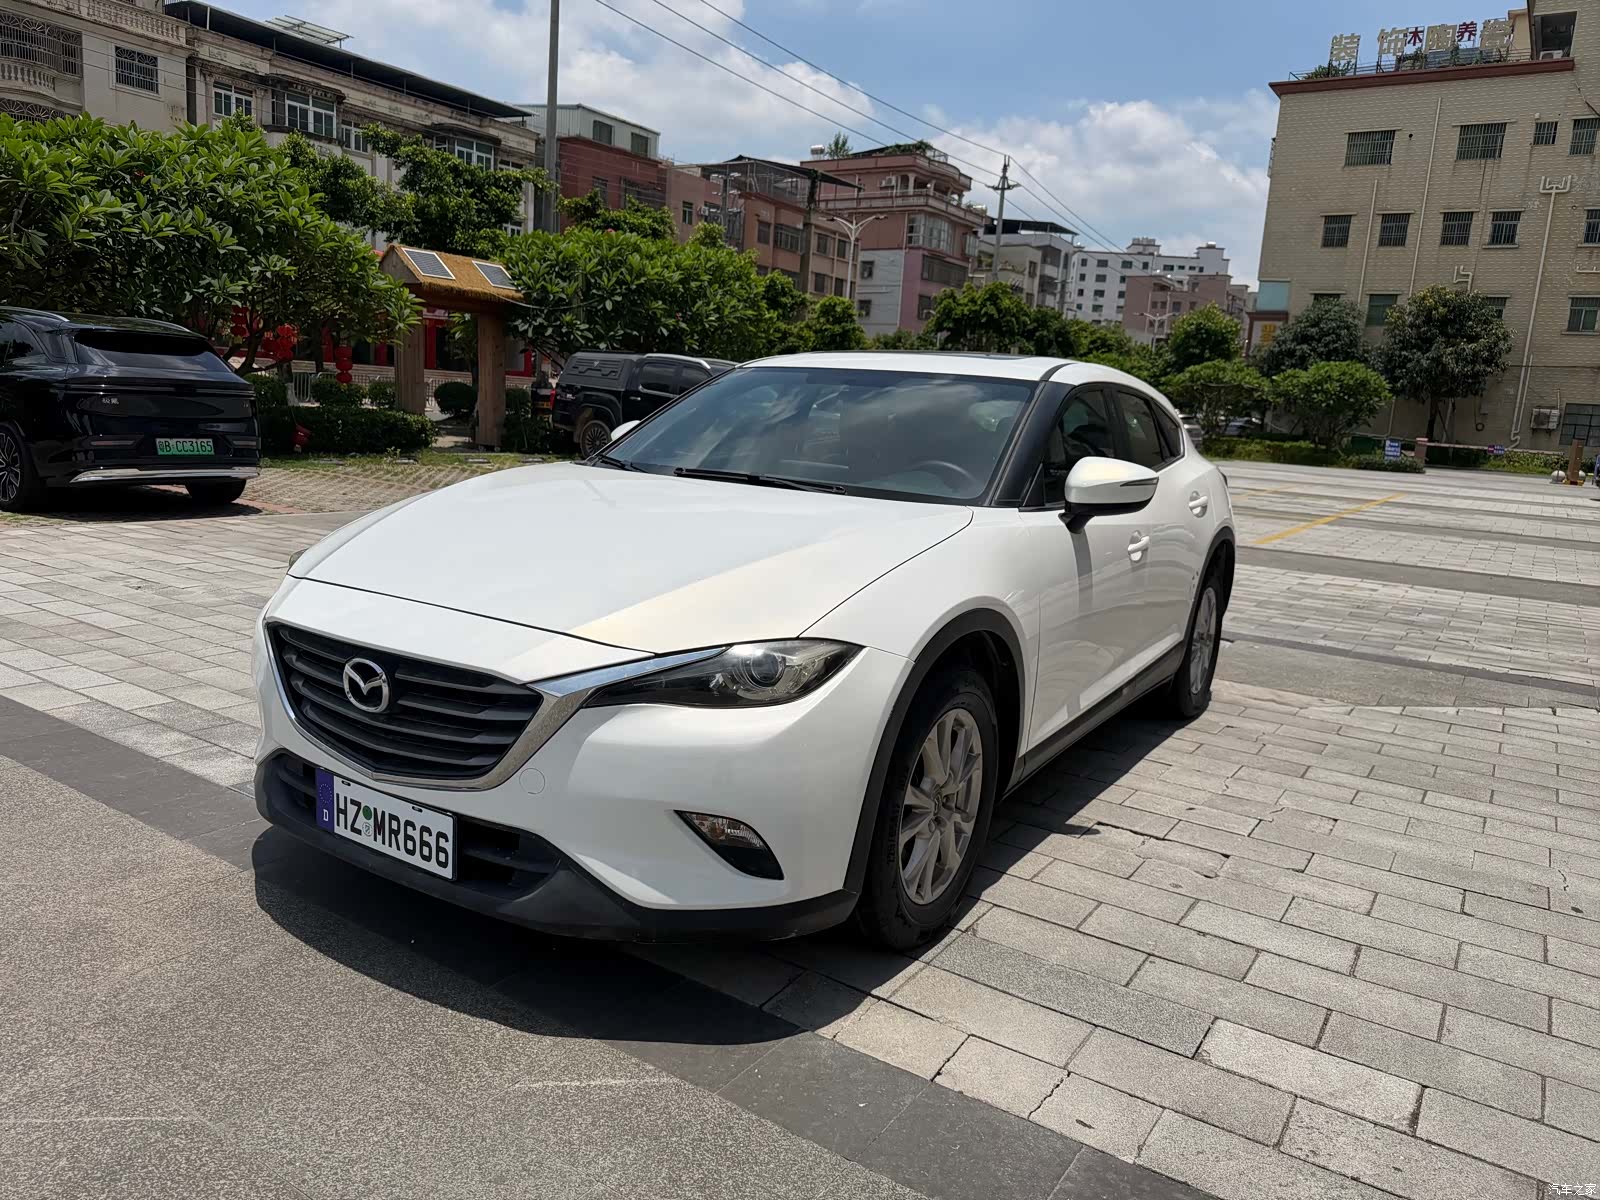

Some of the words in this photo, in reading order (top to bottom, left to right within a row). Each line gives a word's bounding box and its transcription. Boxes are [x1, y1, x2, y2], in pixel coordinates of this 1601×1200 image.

[323, 808, 329, 822] D
[336, 793, 362, 836] HZ
[373, 807, 449, 869] MR666
